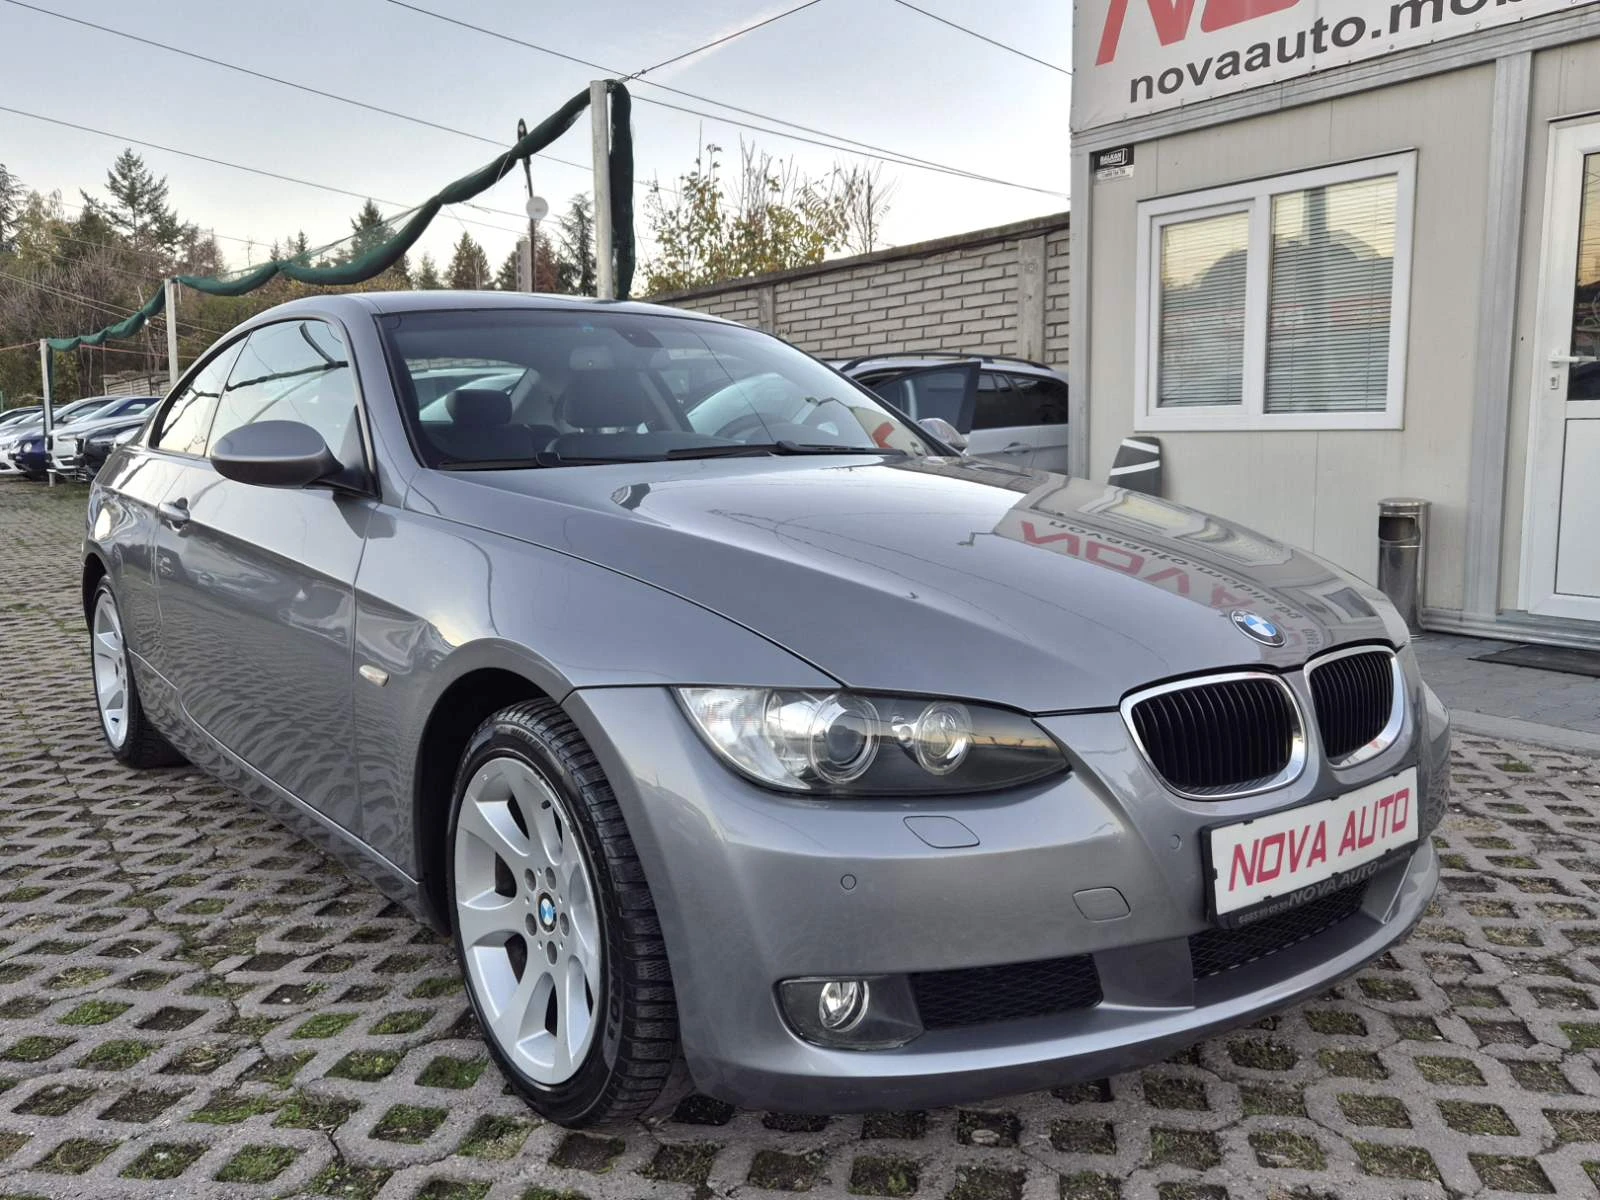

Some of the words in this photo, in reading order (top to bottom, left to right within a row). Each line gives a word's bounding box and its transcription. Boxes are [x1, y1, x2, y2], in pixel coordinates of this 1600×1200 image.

[1130, 0, 1526, 103] novaauto.m
[1228, 819, 1327, 892] NOVA
[1338, 787, 1410, 857] AUTO
[1288, 878, 1337, 907] NOVA
[1337, 861, 1378, 887] AUTO
